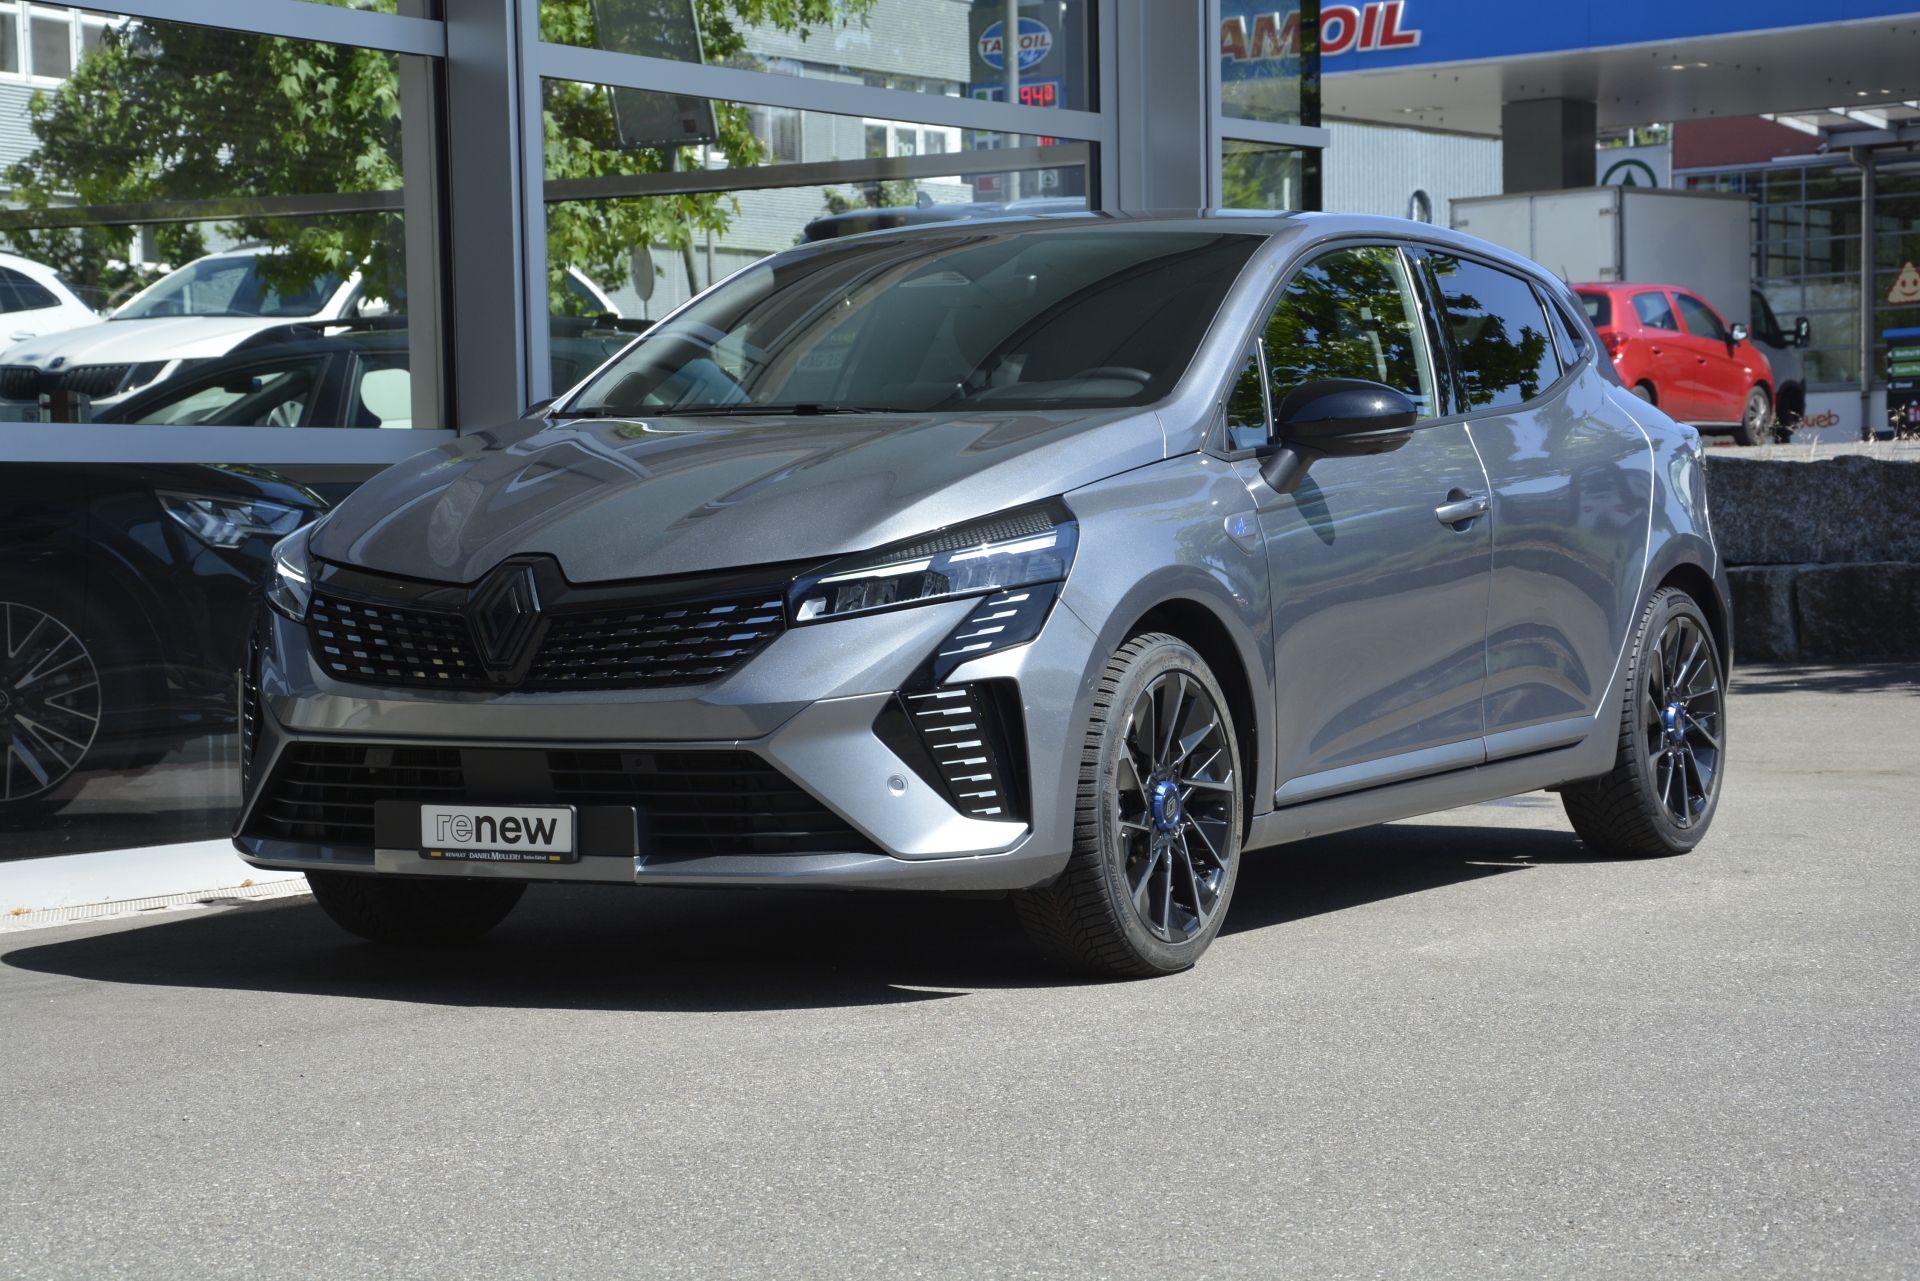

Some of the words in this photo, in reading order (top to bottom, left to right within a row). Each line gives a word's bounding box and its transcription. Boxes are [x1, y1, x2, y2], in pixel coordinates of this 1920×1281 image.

[981, 34, 1050, 53] TAOIL
[1221, 1, 1422, 61] AMOIL
[436, 814, 557, 845] renew
